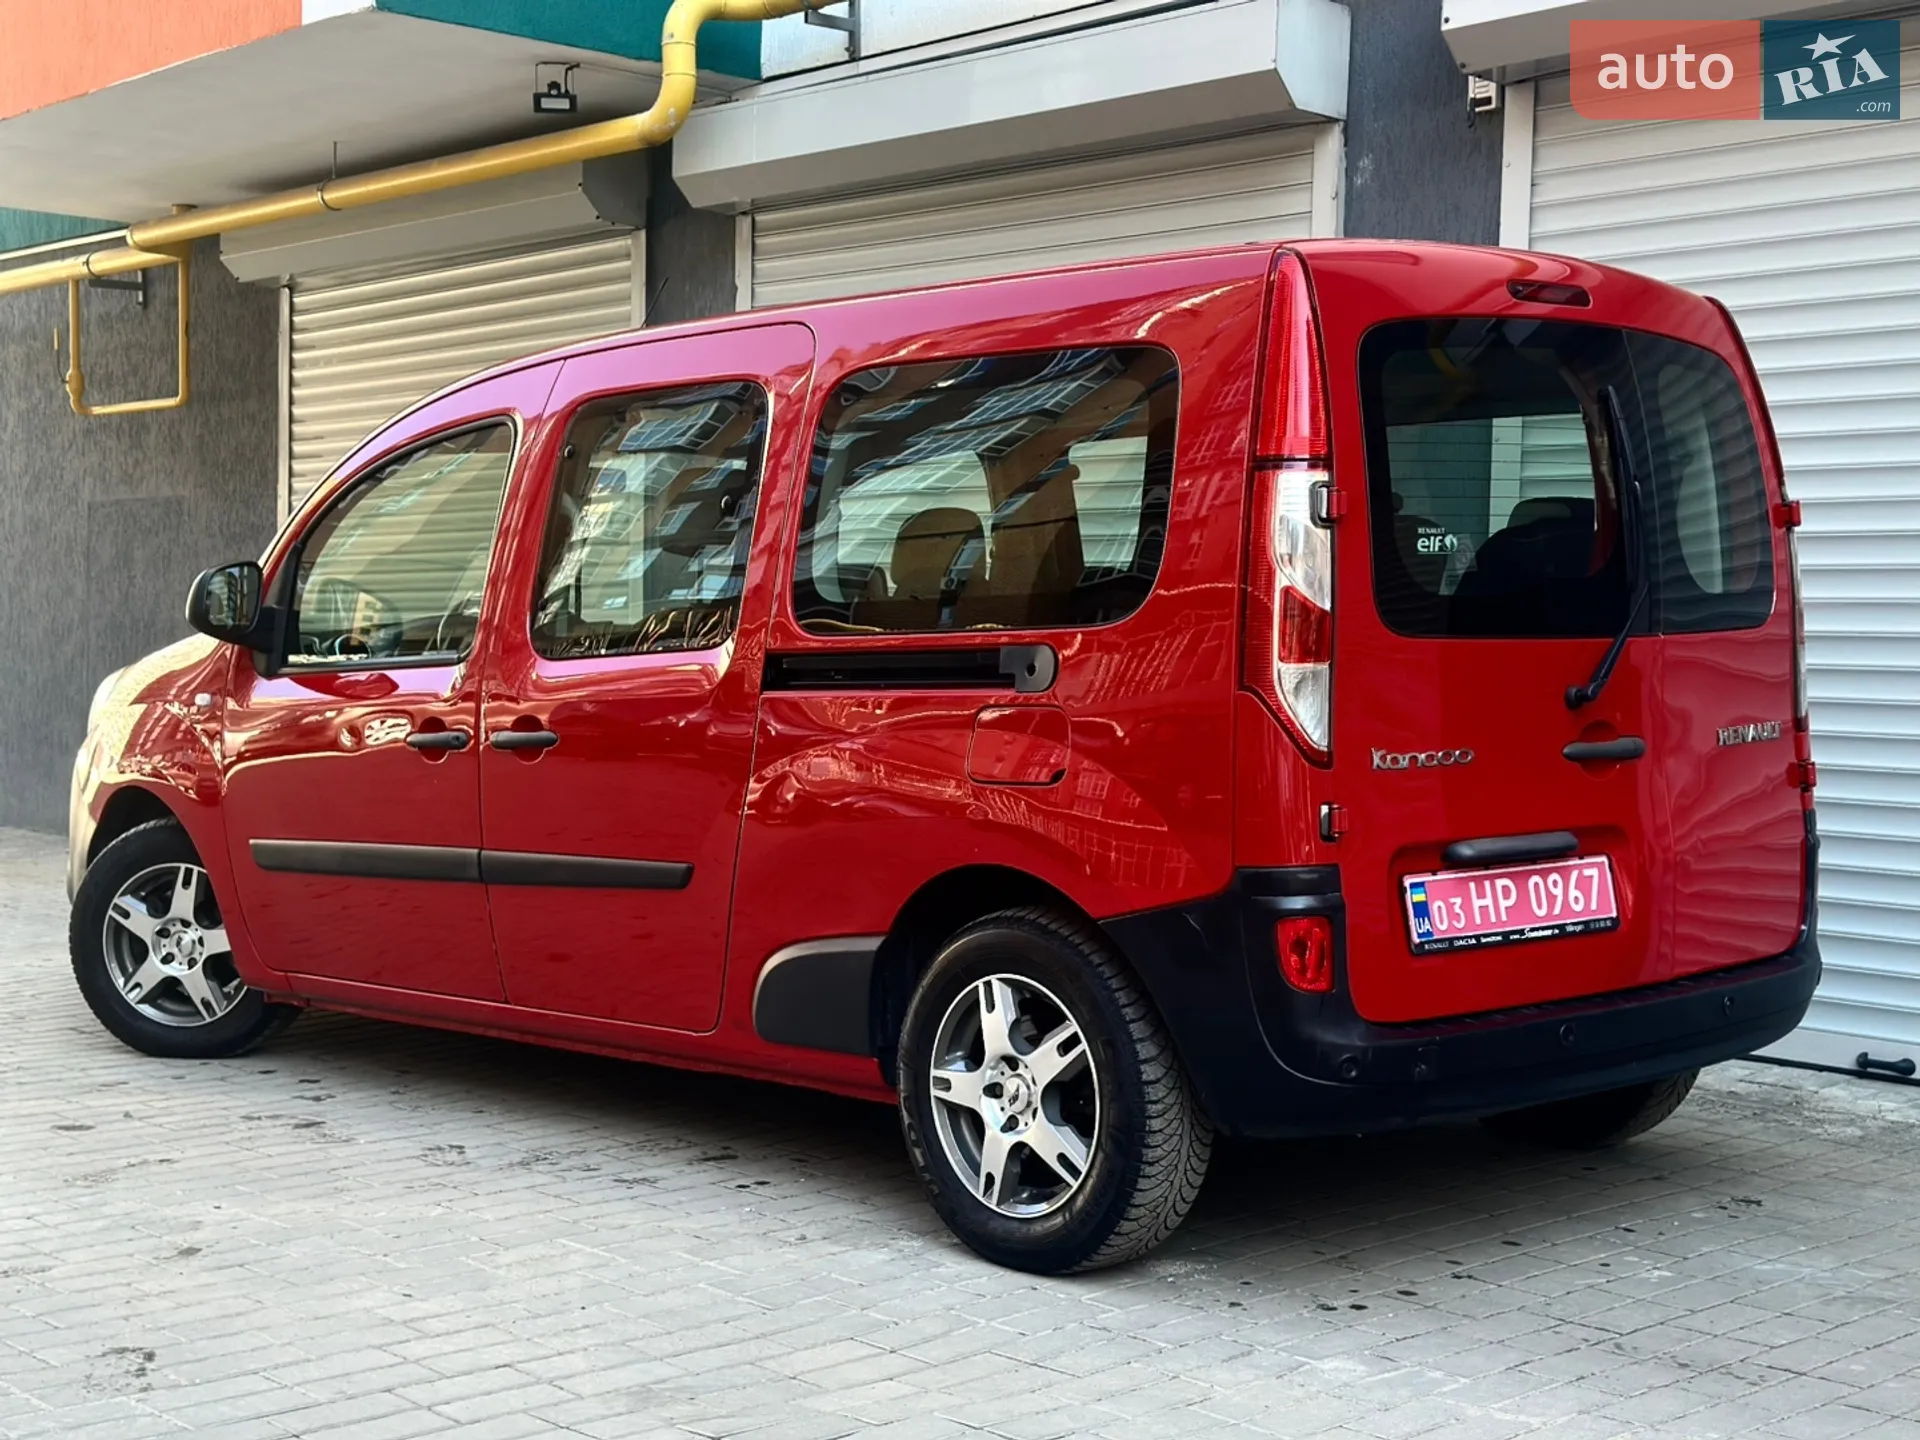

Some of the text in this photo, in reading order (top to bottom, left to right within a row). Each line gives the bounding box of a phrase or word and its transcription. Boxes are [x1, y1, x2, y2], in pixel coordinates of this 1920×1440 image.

[1417, 535, 1444, 552] elf
[1716, 720, 1782, 746] RENAULT
[1432, 867, 1600, 931] 03 HP 0967
[1415, 917, 1433, 934] UA
